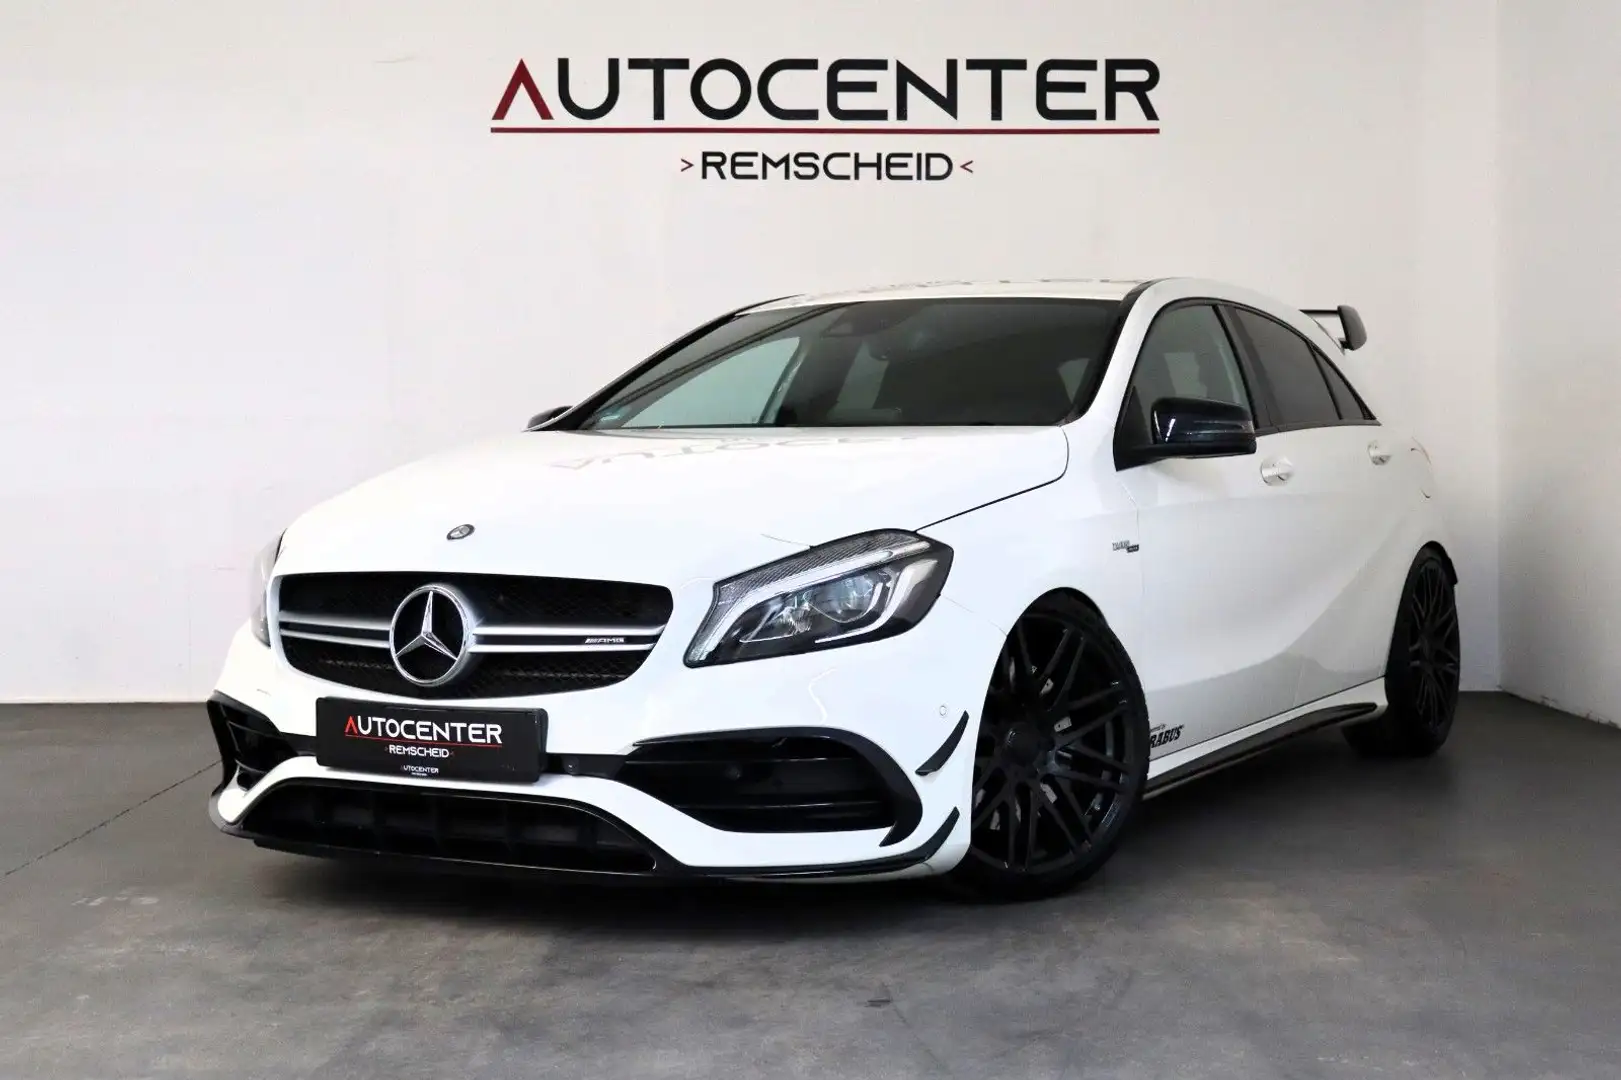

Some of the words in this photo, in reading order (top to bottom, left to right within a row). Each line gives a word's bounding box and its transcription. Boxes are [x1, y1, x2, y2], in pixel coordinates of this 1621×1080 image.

[491, 58, 1160, 121] AUTOCENTER
[701, 151, 953, 180] REMSCHEID
[344, 715, 502, 744] AUTOCENTER
[1150, 724, 1184, 748] RABUS
[389, 744, 450, 758] REMSCHEID
